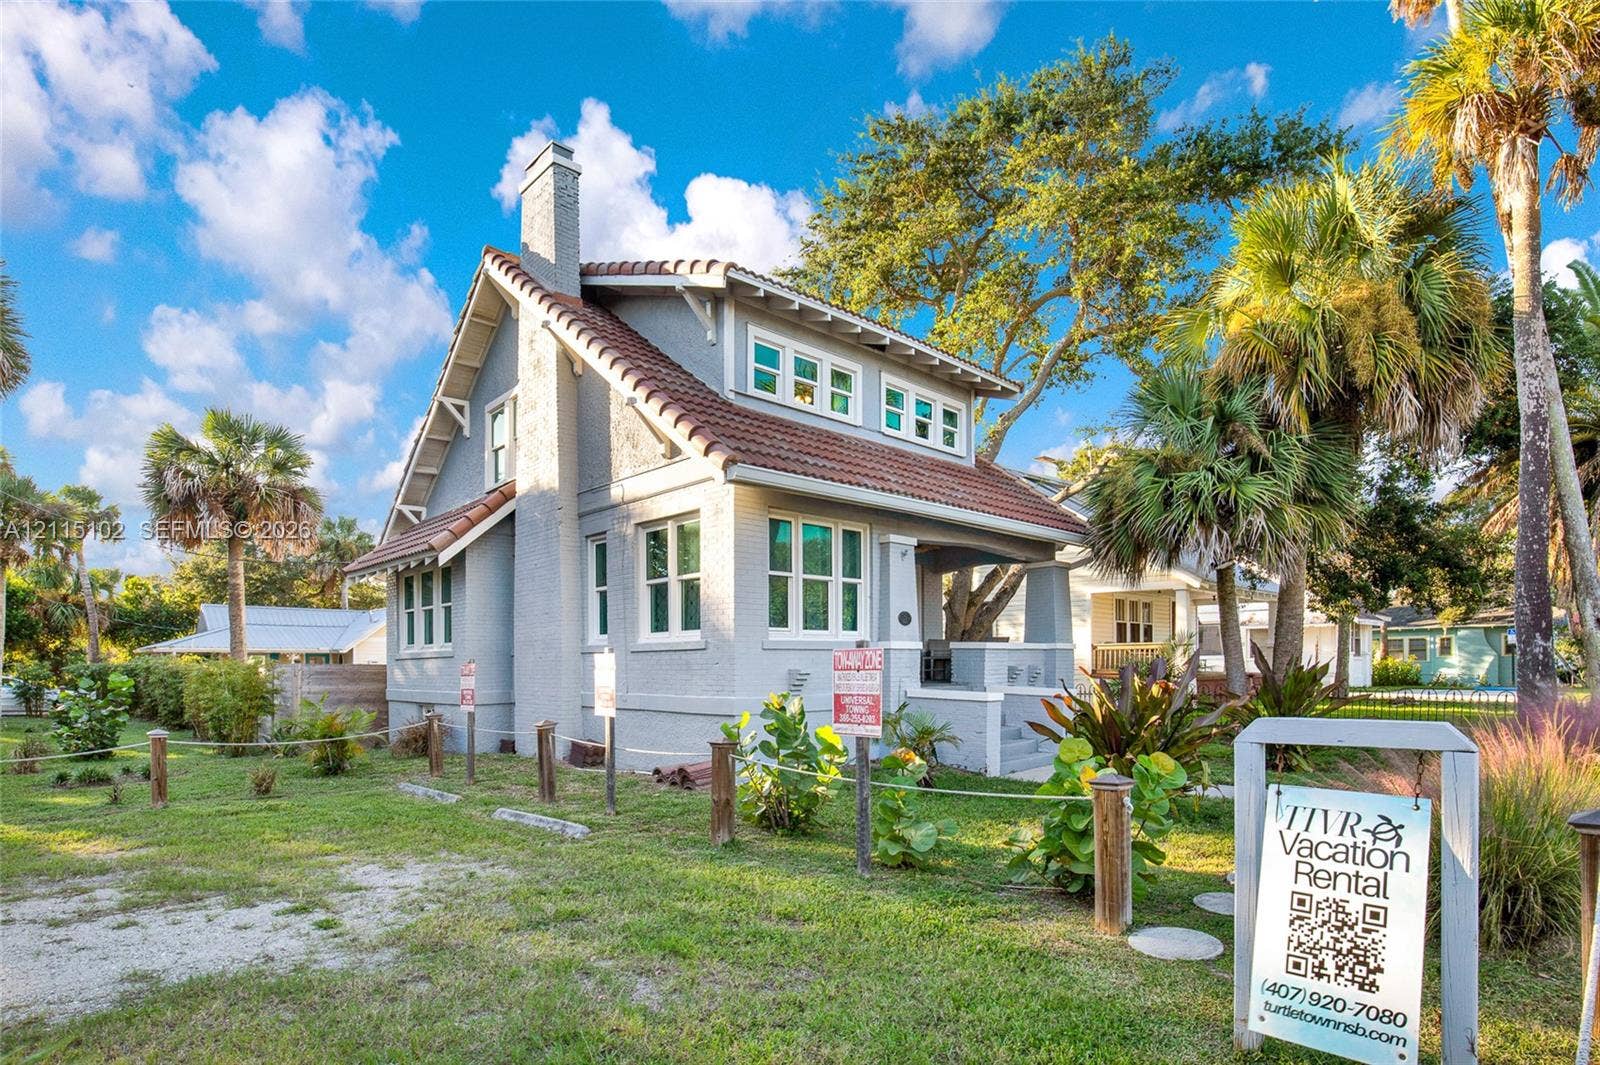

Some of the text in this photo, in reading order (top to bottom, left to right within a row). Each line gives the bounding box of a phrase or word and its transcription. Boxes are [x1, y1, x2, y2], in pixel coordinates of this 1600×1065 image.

[834, 650, 882, 670] TOW-AWAY ZONE
[840, 695, 875, 705] UNIVERSAL
[845, 704, 870, 714] TOWING
[1278, 829, 1411, 873] Vacation
[1293, 860, 1390, 900] Rental
[1260, 977, 1408, 1029] (407) 920-7080
[1263, 1000, 1408, 1048] turtletownnsb.com
